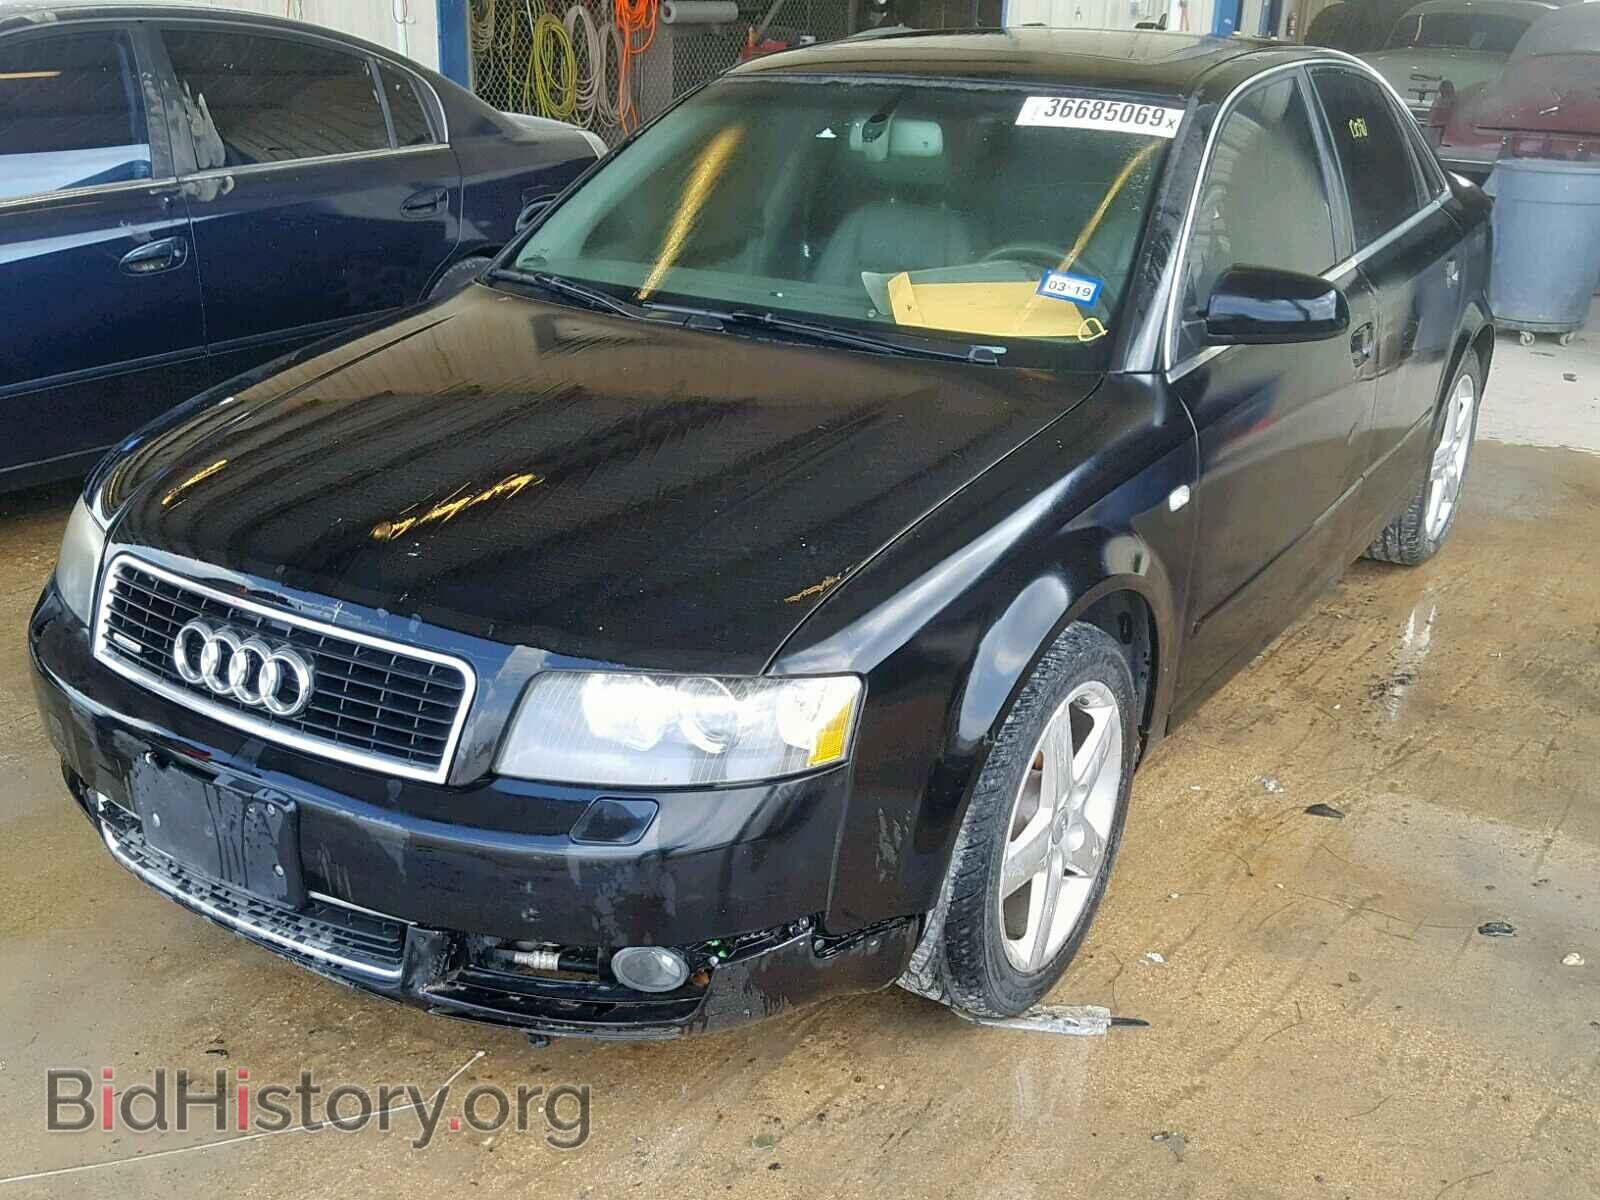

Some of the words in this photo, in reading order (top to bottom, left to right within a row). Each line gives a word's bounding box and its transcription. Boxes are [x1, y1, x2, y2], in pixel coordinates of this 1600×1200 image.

[1044, 98, 1166, 127] 36685069
[1048, 279, 1067, 292] 03
[1072, 286, 1092, 297] 19
